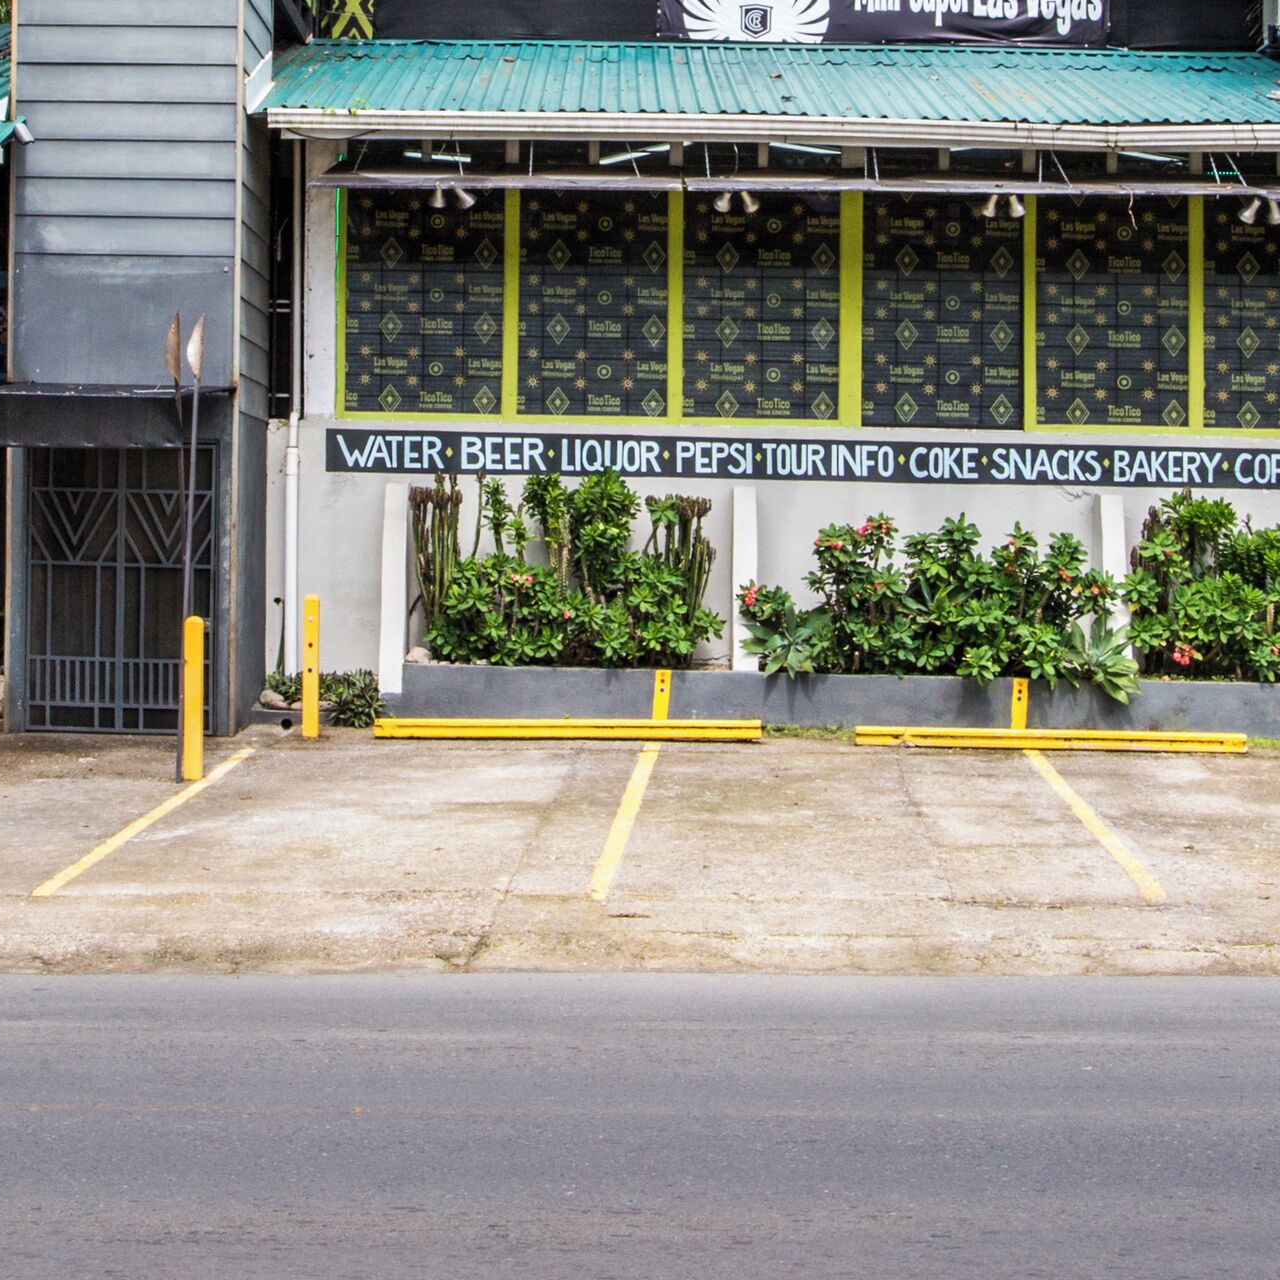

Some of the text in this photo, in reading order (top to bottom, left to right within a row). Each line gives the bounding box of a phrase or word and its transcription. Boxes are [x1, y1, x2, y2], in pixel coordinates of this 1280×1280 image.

[650, 361, 667, 372] Vega
[1170, 372, 1188, 383] Vega
[337, 434, 445, 470] WATER
[461, 436, 544, 472] BEER
[561, 438, 660, 474] LIQUOR
[677, 441, 753, 475] PEPSI
[762, 443, 826, 476] TOUR
[831, 445, 894, 478] INFO
[909, 447, 979, 480] COKE
[991, 449, 1102, 482] SNACKS
[1113, 451, 1221, 483] BAKERY
